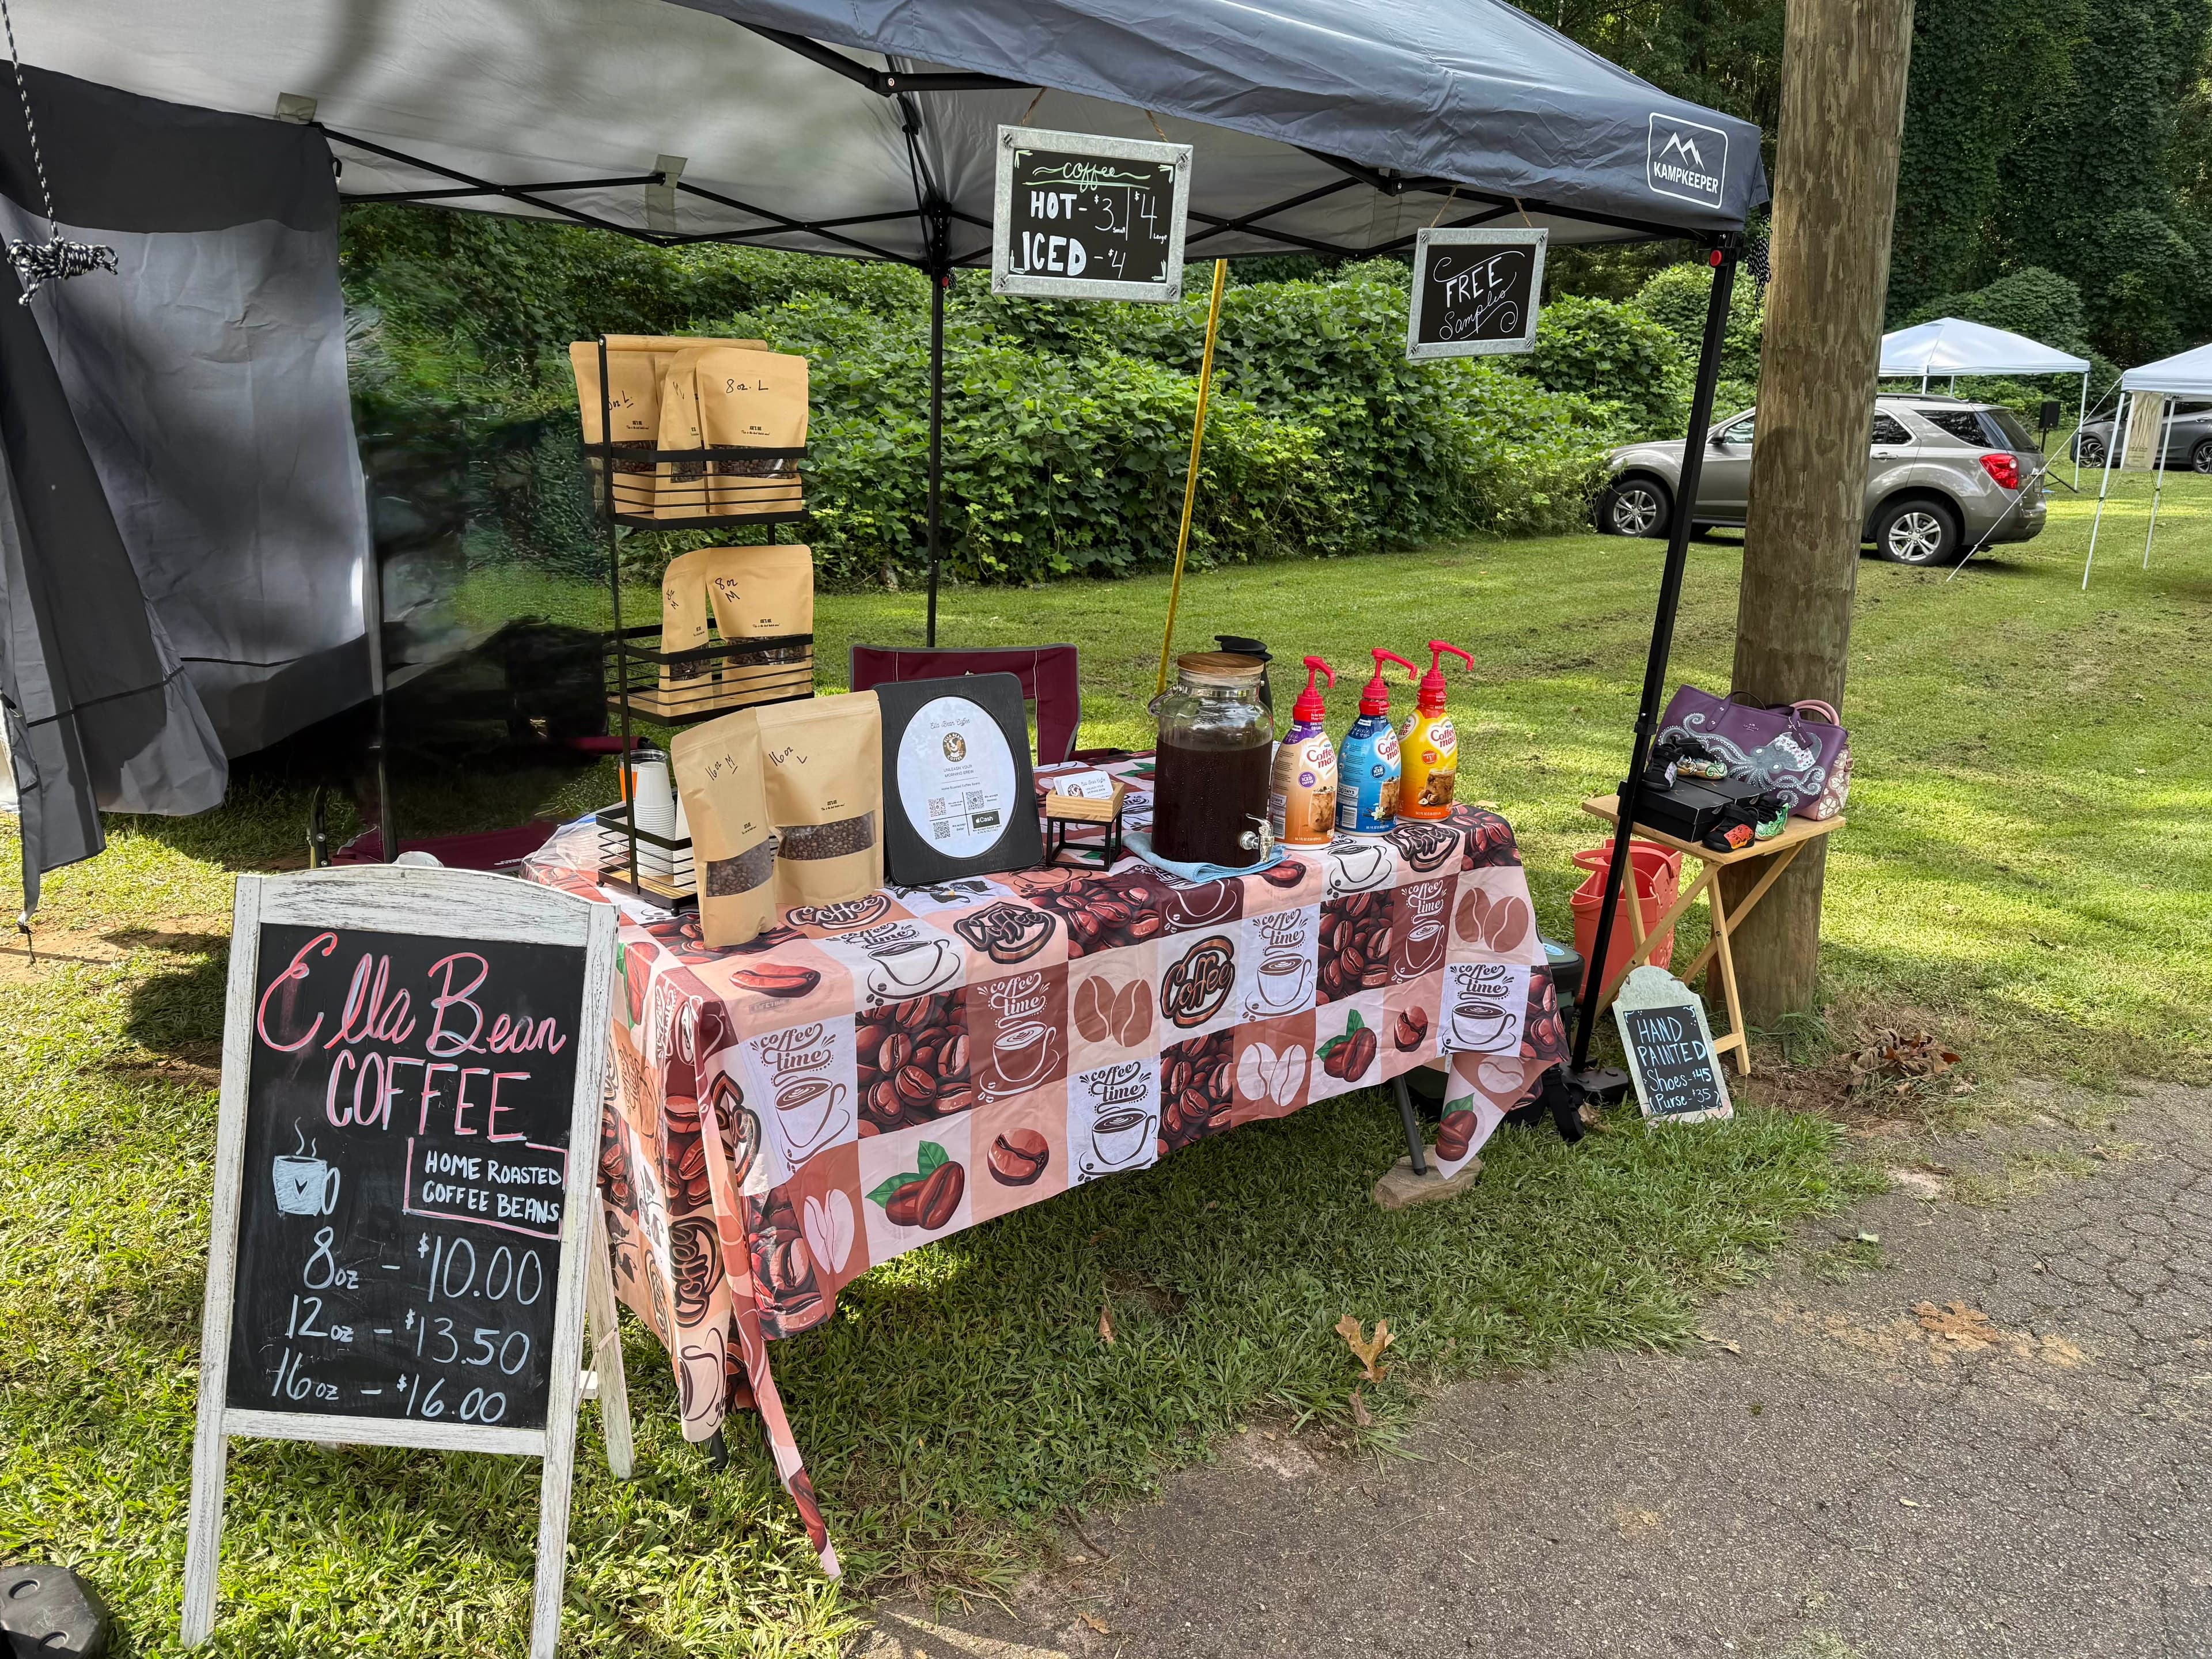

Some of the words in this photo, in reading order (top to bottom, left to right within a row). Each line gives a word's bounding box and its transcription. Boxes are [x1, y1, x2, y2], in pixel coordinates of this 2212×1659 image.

[1063, 162, 1115, 193] coffee
[1654, 162, 1718, 194] KAMPKEEPER
[1031, 191, 1077, 219] HOT
[1094, 194, 1114, 231] $3
[1134, 191, 1157, 239] $4
[1153, 233, 1167, 245] Large
[1022, 231, 1086, 276] ICED
[1108, 248, 1126, 279] $4
[1446, 256, 1503, 308] FREE
[1440, 282, 1510, 340] Samples
[758, 380, 769, 391] L
[725, 590, 740, 603] M
[725, 753, 735, 768] M
[797, 756, 807, 764] L
[1408, 880, 1443, 897] coffee
[1262, 908, 1301, 931] coffee
[1415, 898, 1444, 915] time
[858, 929, 917, 945] time
[1264, 929, 1305, 948] time
[990, 972, 1041, 998] coffee
[1160, 939, 1236, 1027] Coffee
[1458, 964, 1506, 981] coffee
[1463, 978, 1509, 993] time
[256, 931, 416, 1053] Ella
[426, 952, 567, 1057] Bean
[995, 995, 1047, 1017] time
[760, 1023, 823, 1052] coffee
[1637, 1016, 1682, 1044] HAND
[771, 1048, 831, 1072] time
[1637, 1040, 1706, 1066] PAINTED
[1090, 1061, 1141, 1085] coffee
[325, 1049, 531, 1143] COFFEE
[1096, 1083, 1146, 1103] time
[425, 1152, 480, 1181] HOME
[487, 1159, 562, 1186] ROASTED
[423, 1180, 490, 1209] COFFEE
[497, 1193, 559, 1221] BEANS
[416, 1232, 543, 1305] $10.00
[405, 1309, 531, 1376] $13.50
[397, 1373, 507, 1423] $16.00
